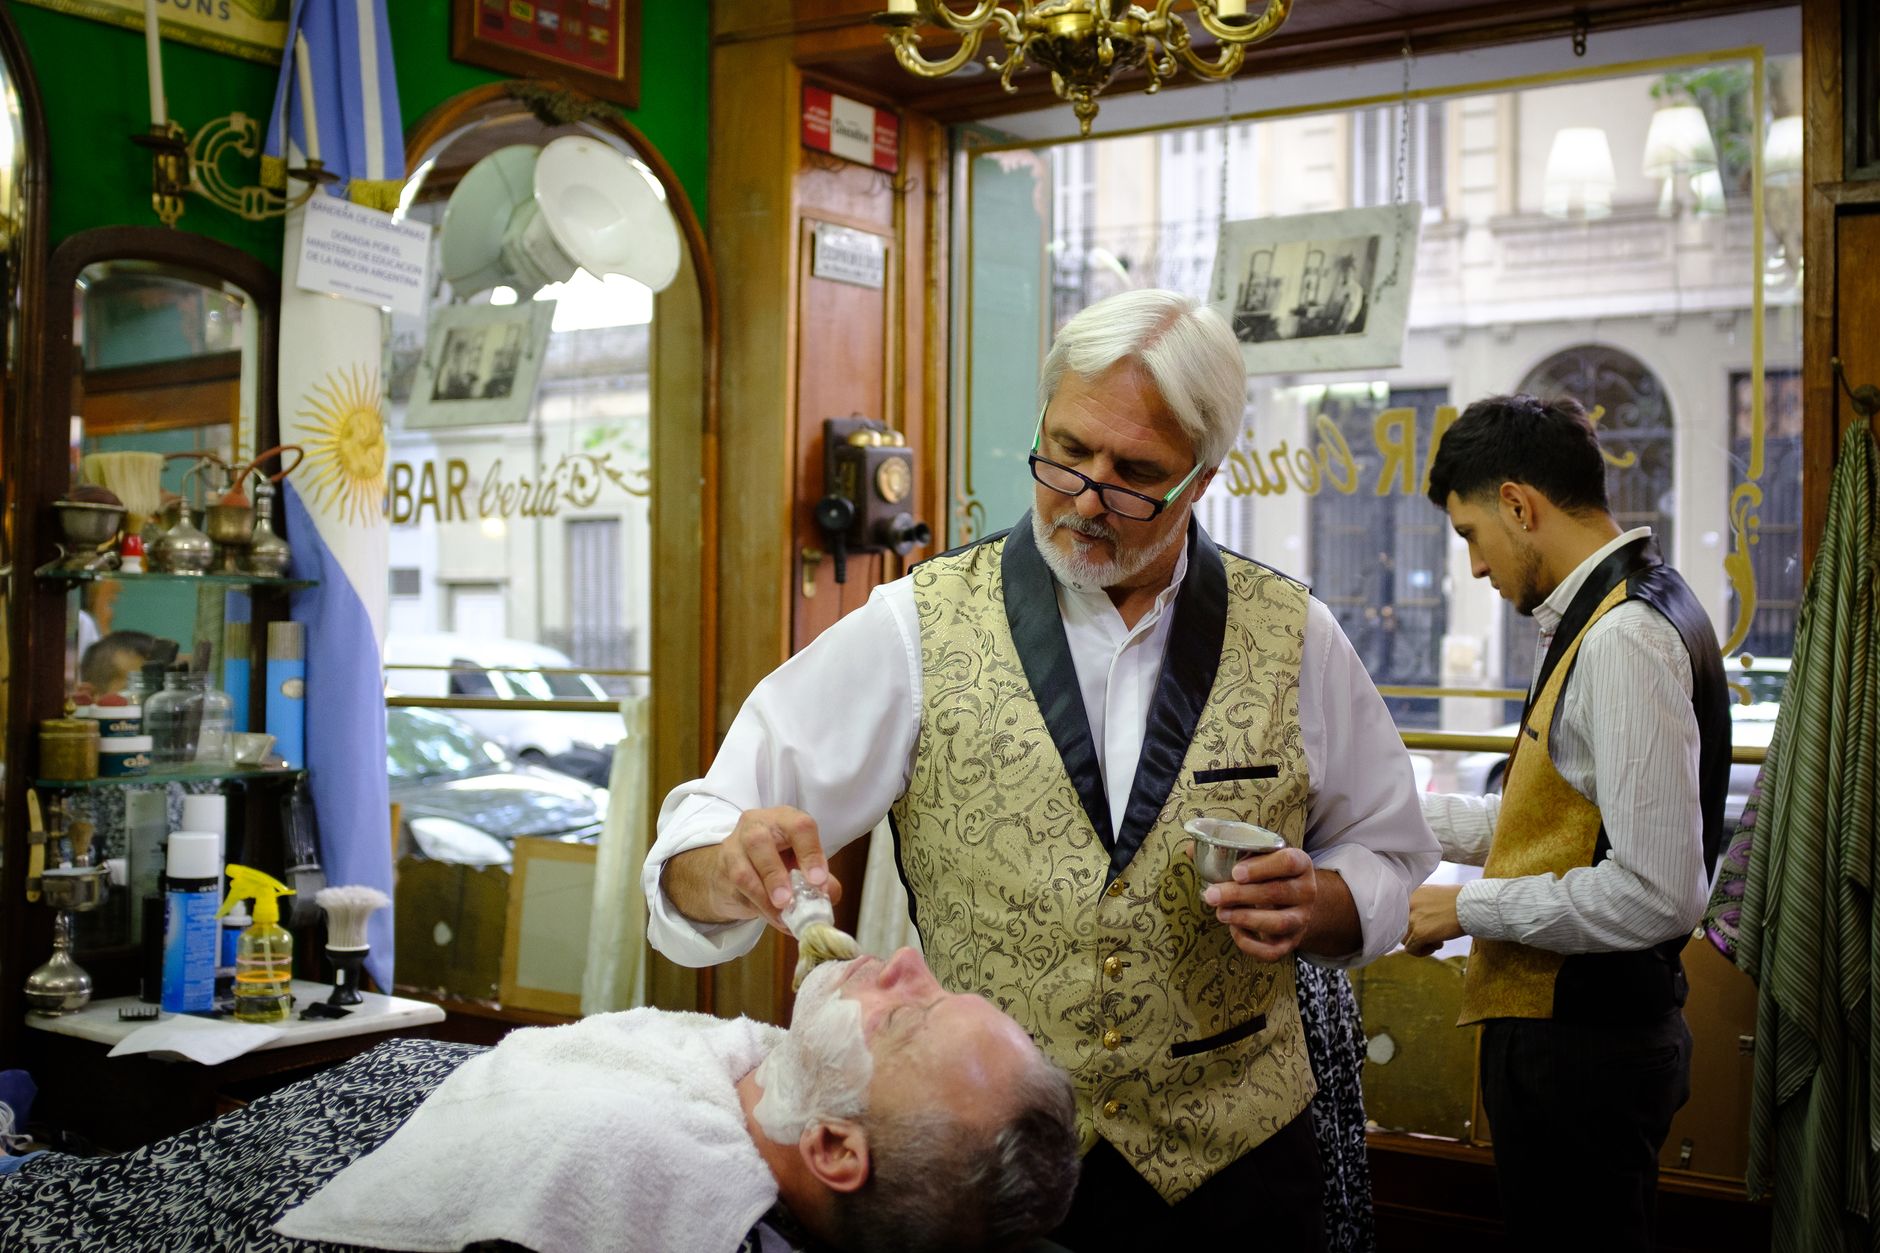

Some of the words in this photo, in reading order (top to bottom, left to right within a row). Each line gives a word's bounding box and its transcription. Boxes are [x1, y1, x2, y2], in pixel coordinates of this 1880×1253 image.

[310, 201, 353, 220] BANDERA
[356, 213, 368, 223] DE
[306, 236, 357, 257] MINISTERIO
[358, 250, 370, 262] DE
[331, 229, 371, 247] DONADA
[372, 239, 390, 253] POR
[306, 250, 318, 262] DE
[320, 252, 332, 264] LA
[371, 269, 419, 288] ARGENTINA
[391, 457, 470, 524] BAR
